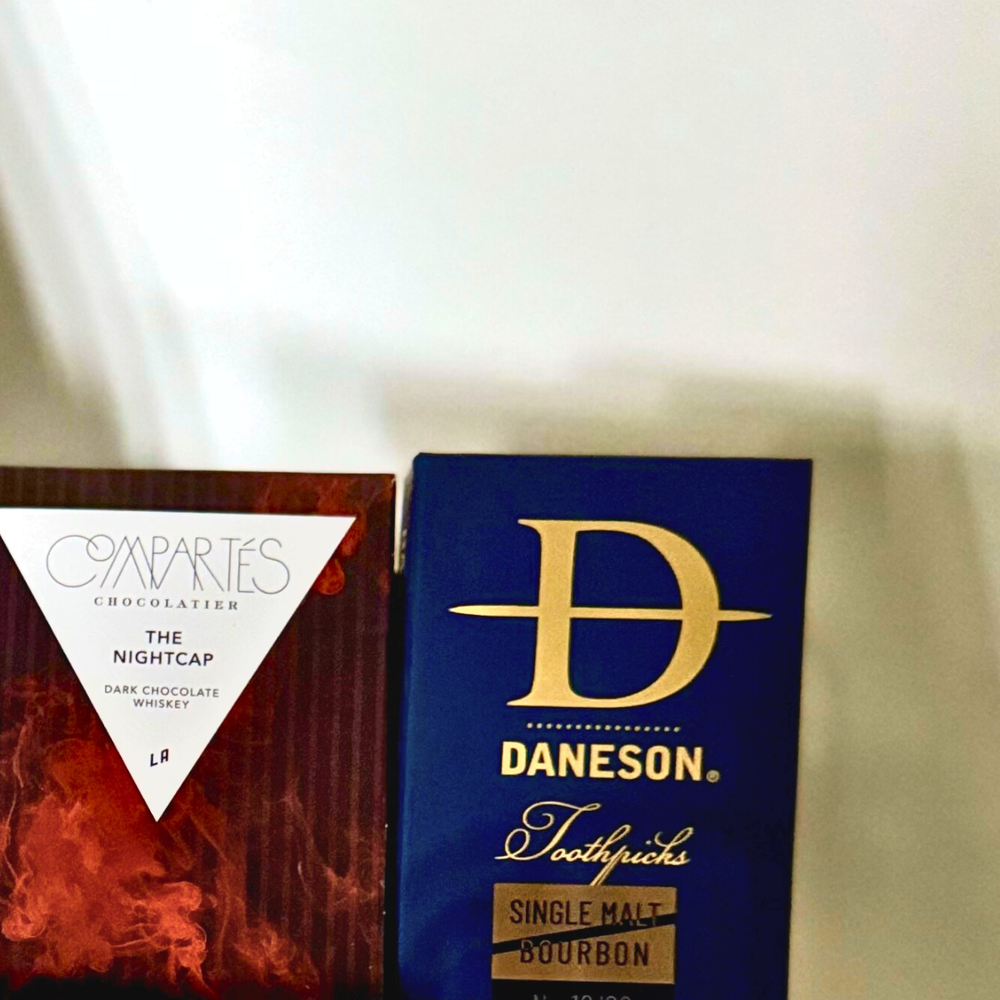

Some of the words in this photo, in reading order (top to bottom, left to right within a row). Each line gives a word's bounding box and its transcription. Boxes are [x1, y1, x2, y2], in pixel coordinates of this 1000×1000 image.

[93, 596, 239, 611] CHOCOLATIER
[507, 518, 720, 708] D
[145, 630, 183, 645] THE
[113, 650, 214, 667] NIGHTCAP
[104, 684, 138, 696] DARK
[142, 686, 220, 698] CHOCOLATE
[133, 698, 190, 710] WHISKEY
[149, 748, 170, 768] LA
[494, 800, 694, 886] Toothpicks
[509, 899, 592, 925] SINGLE
[601, 903, 662, 928] MALT
[519, 940, 649, 967] BOURBON
